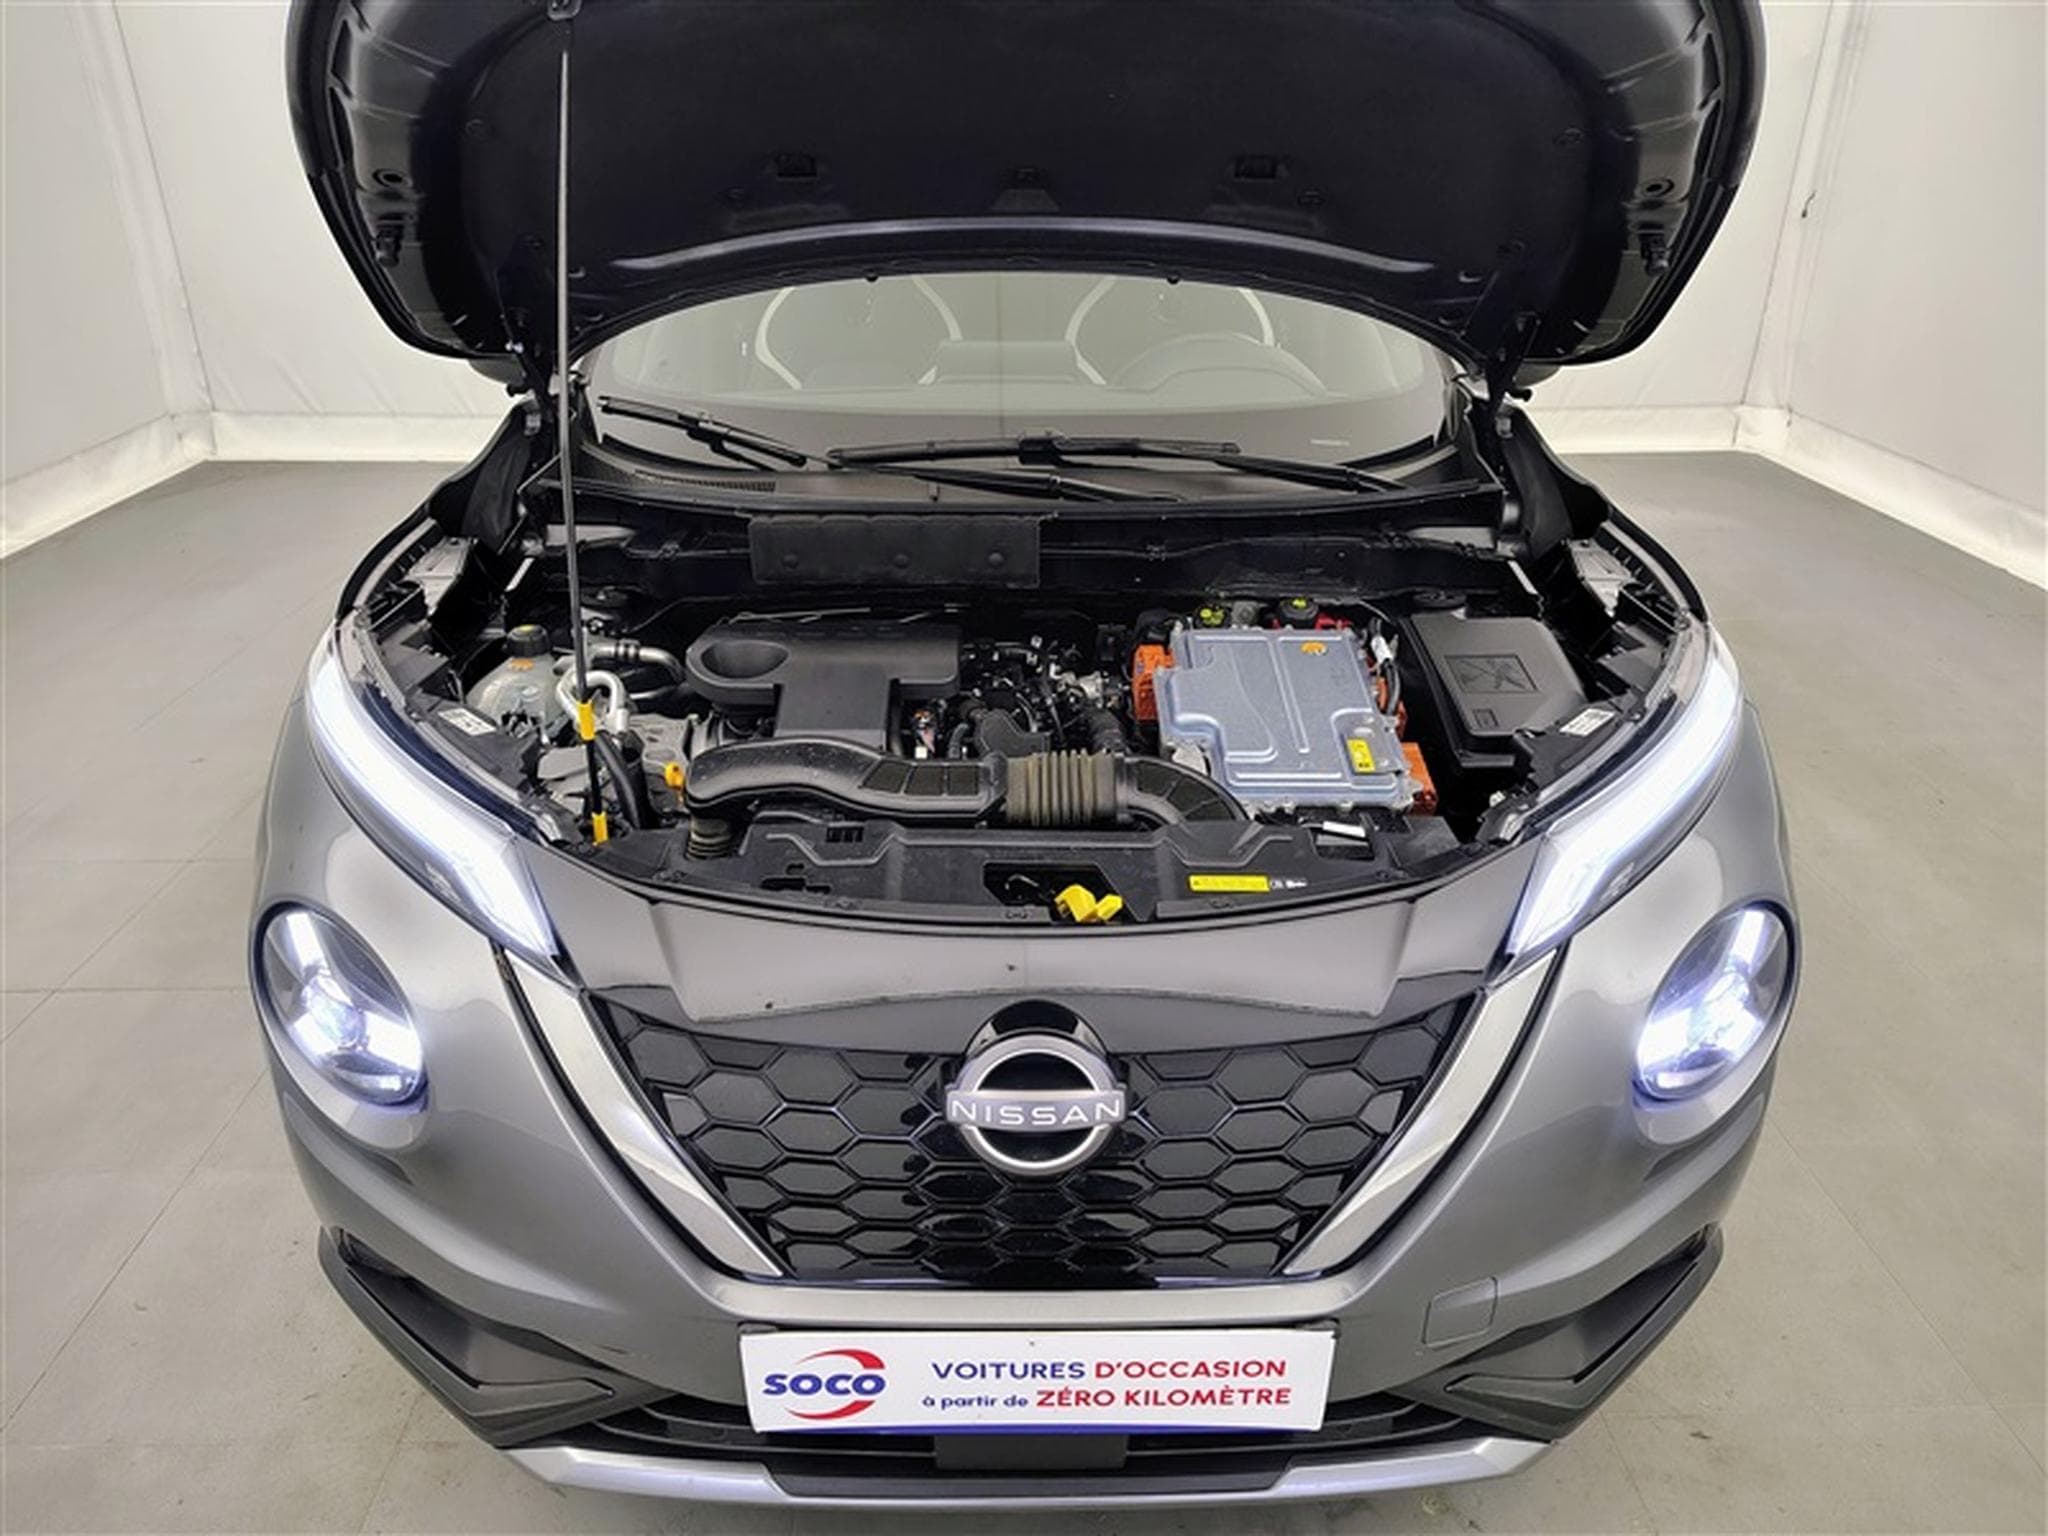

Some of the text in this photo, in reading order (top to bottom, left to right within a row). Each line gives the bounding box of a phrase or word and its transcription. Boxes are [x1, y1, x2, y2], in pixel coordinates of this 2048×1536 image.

[951, 1099, 1121, 1126] NISSAN
[931, 1359, 1287, 1380] VOITURES D'OCCASION
[762, 1373, 886, 1396] SOCO
[921, 1385, 1292, 1411] à partir de ZÉRO KILOMÈTRE
